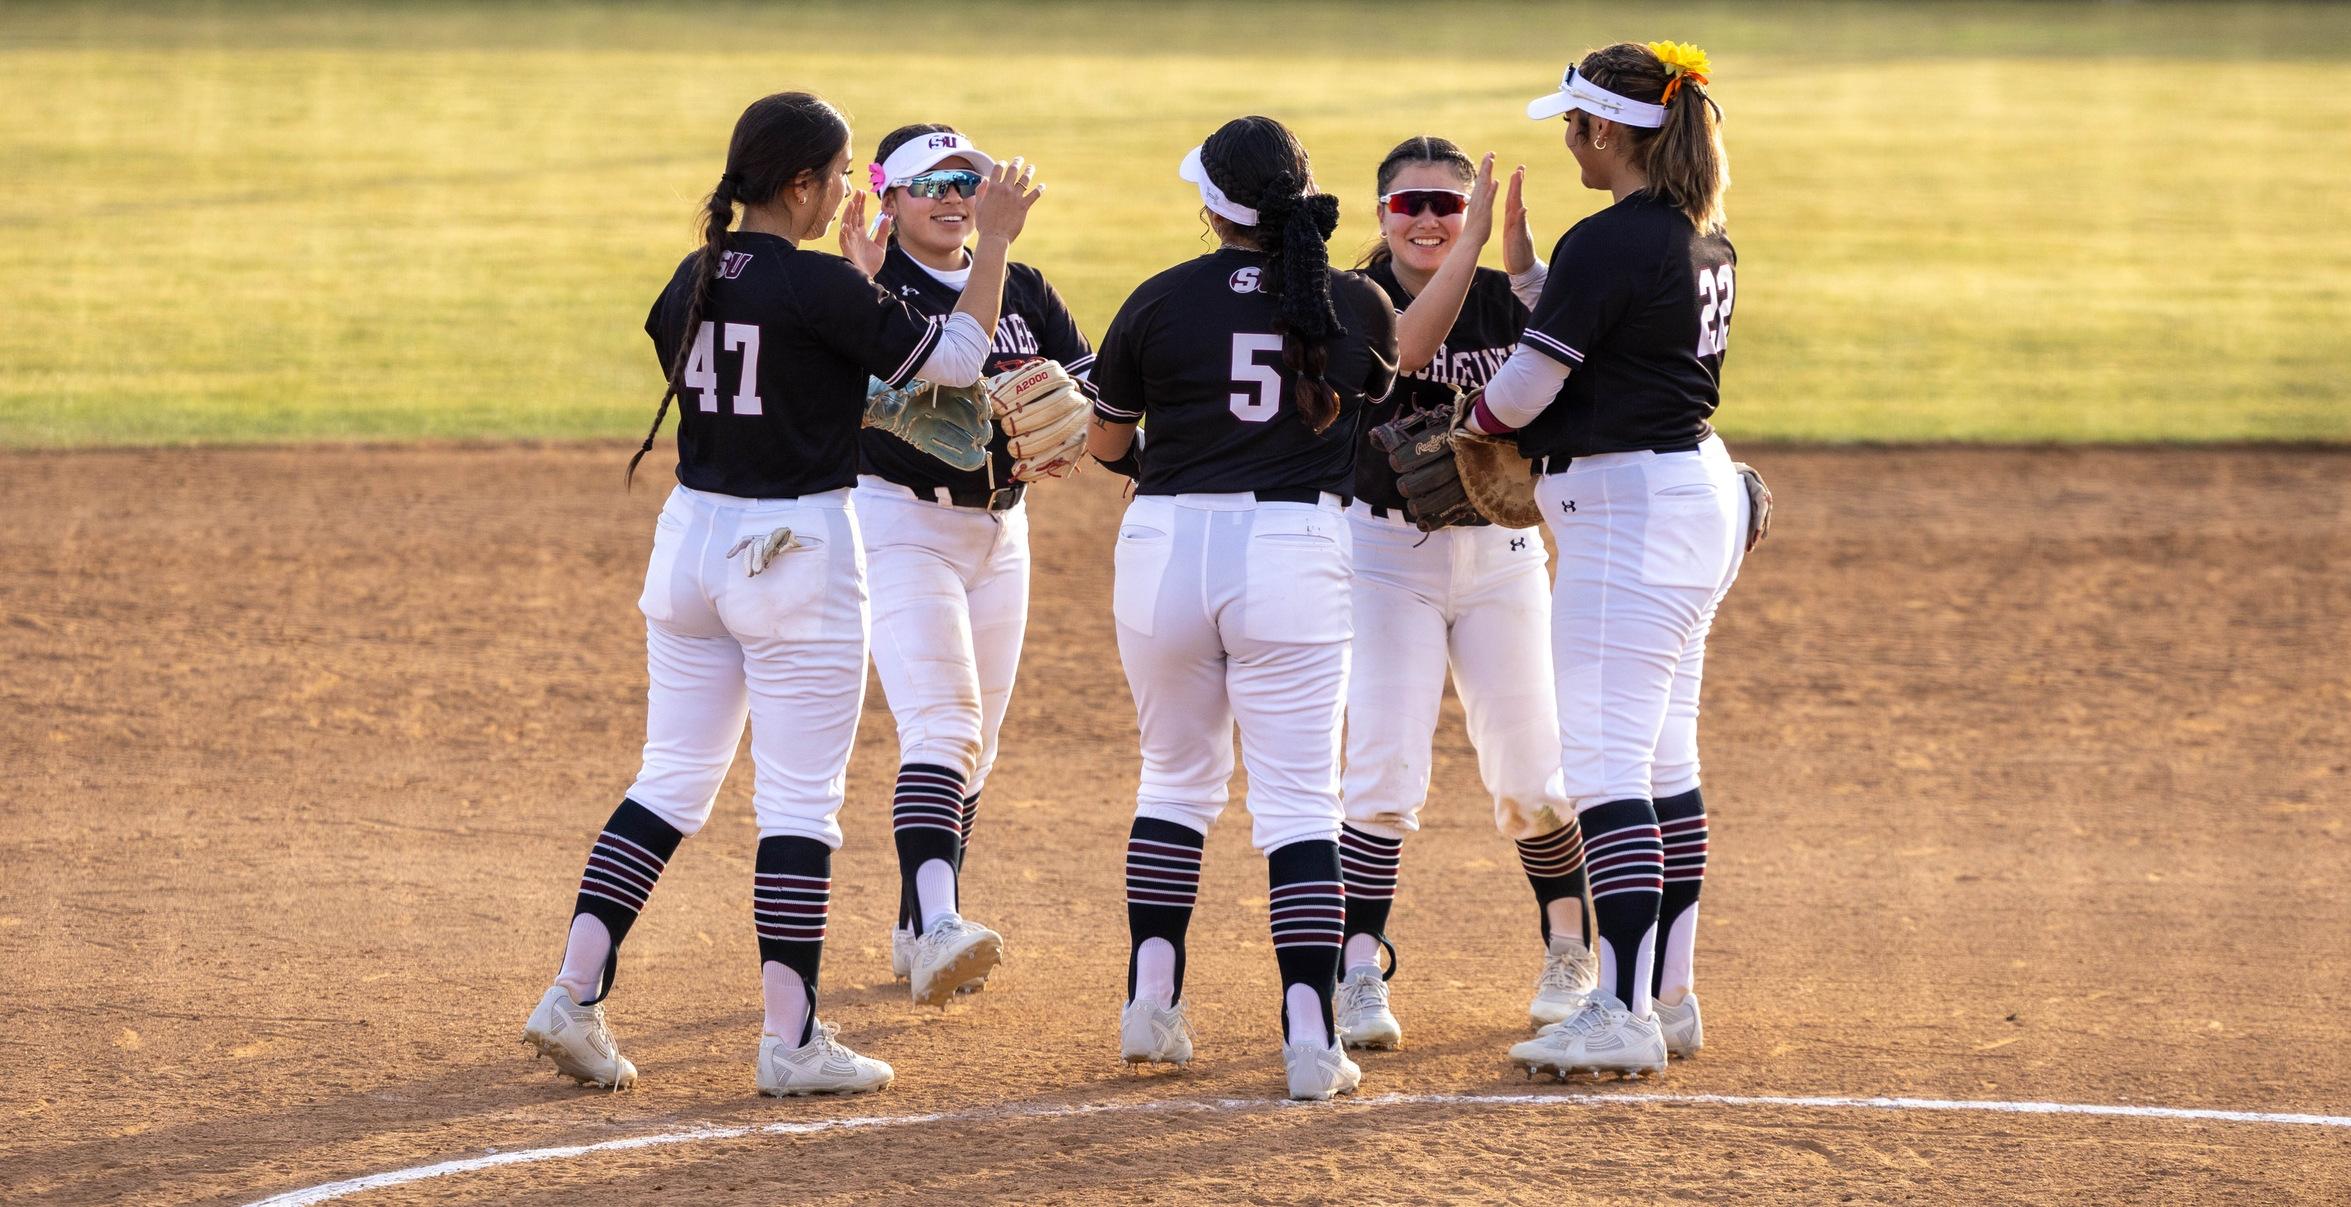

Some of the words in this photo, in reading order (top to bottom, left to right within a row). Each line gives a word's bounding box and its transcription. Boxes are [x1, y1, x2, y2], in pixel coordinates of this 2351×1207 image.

[928, 135, 957, 149] SU
[1229, 266, 1268, 294] S
[1697, 264, 1734, 358] 22
[684, 320, 763, 416] 47
[1229, 333, 1284, 423] 5
[1015, 371, 1049, 395] A2000
[1415, 431, 1449, 456] Rawling
